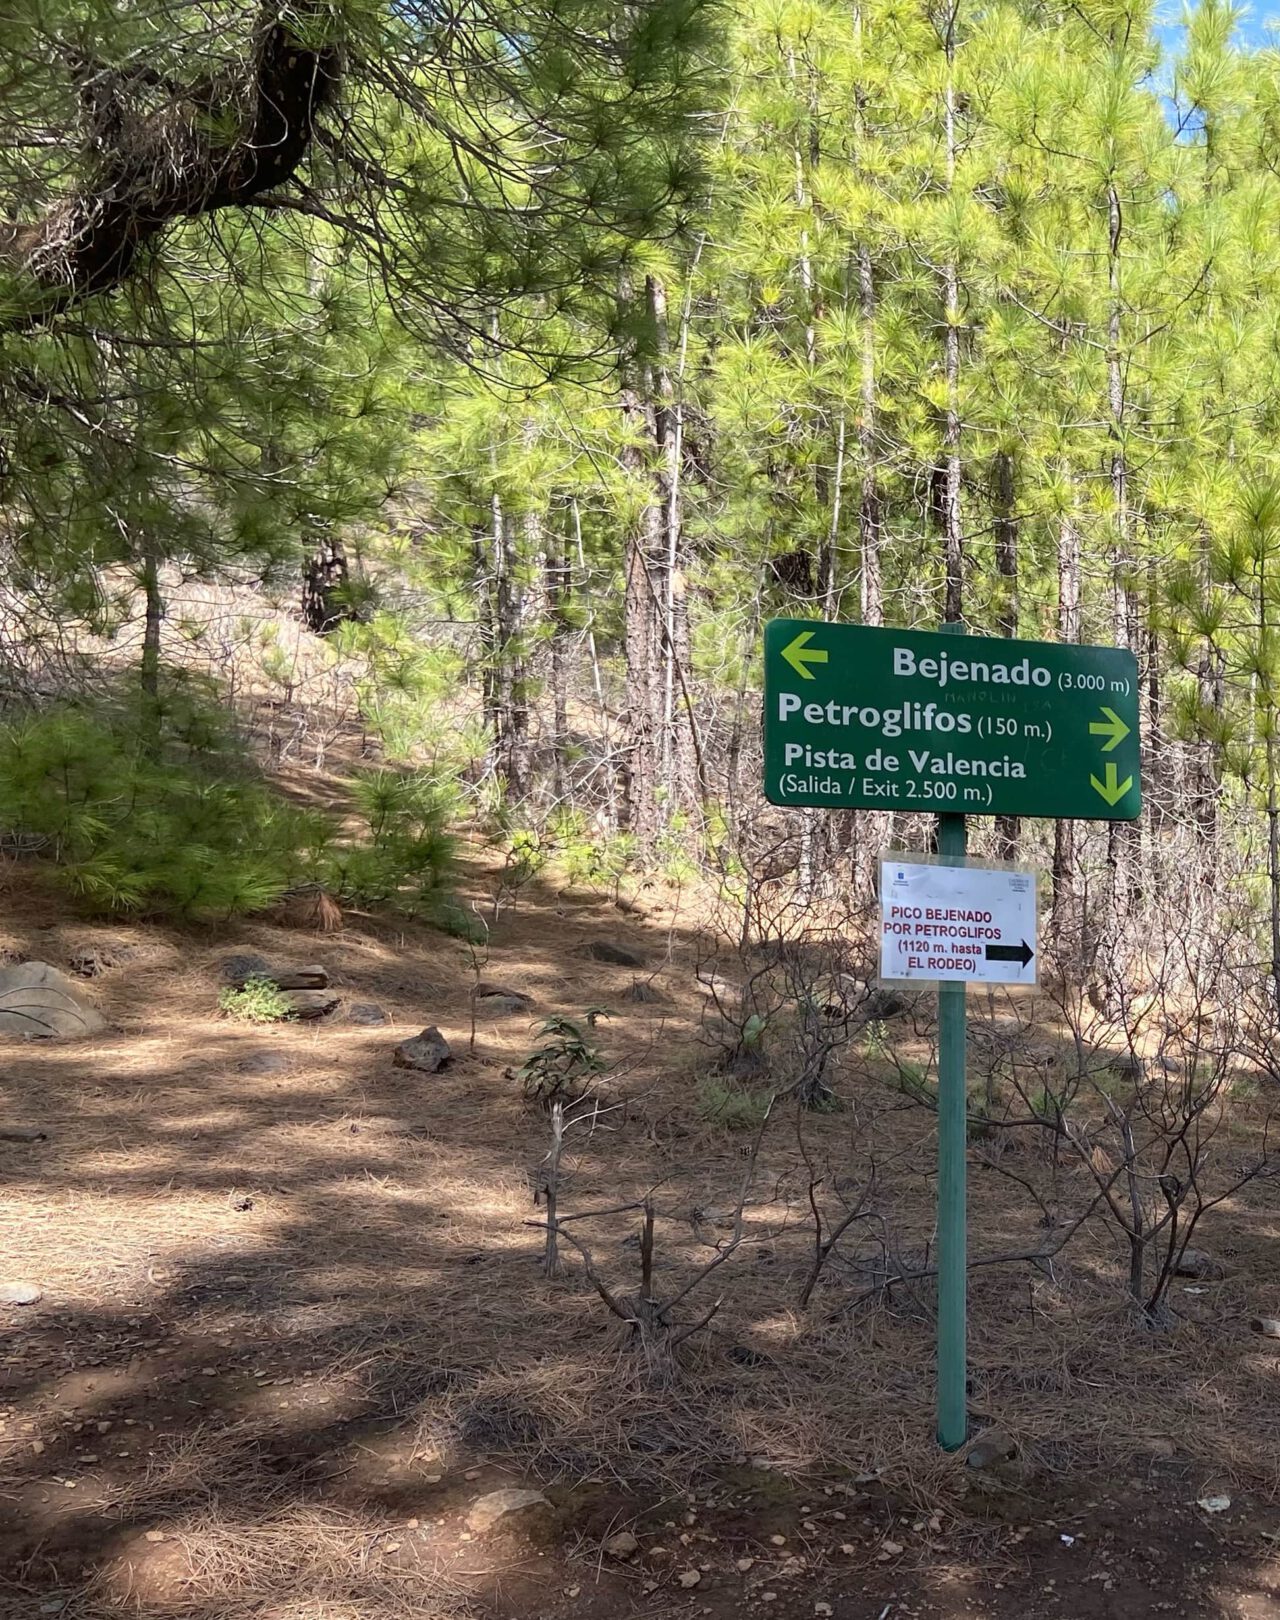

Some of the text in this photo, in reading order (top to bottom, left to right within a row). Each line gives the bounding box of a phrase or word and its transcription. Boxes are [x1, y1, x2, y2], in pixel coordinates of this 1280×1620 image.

[893, 647, 1130, 697] Bejenado (3.000 m)
[778, 692, 1053, 743] Petroglifos (150 m.)
[784, 743, 1027, 778] Pista de Valencia
[779, 773, 993, 805] (Salida / Exit 2.500 m.)
[891, 906, 992, 923] PICO BEJENADO
[884, 922, 1002, 940] POR PETROGLIFOS
[898, 939, 982, 955] (1120 m. hasta
[908, 956, 976, 973] EL RODEO)
